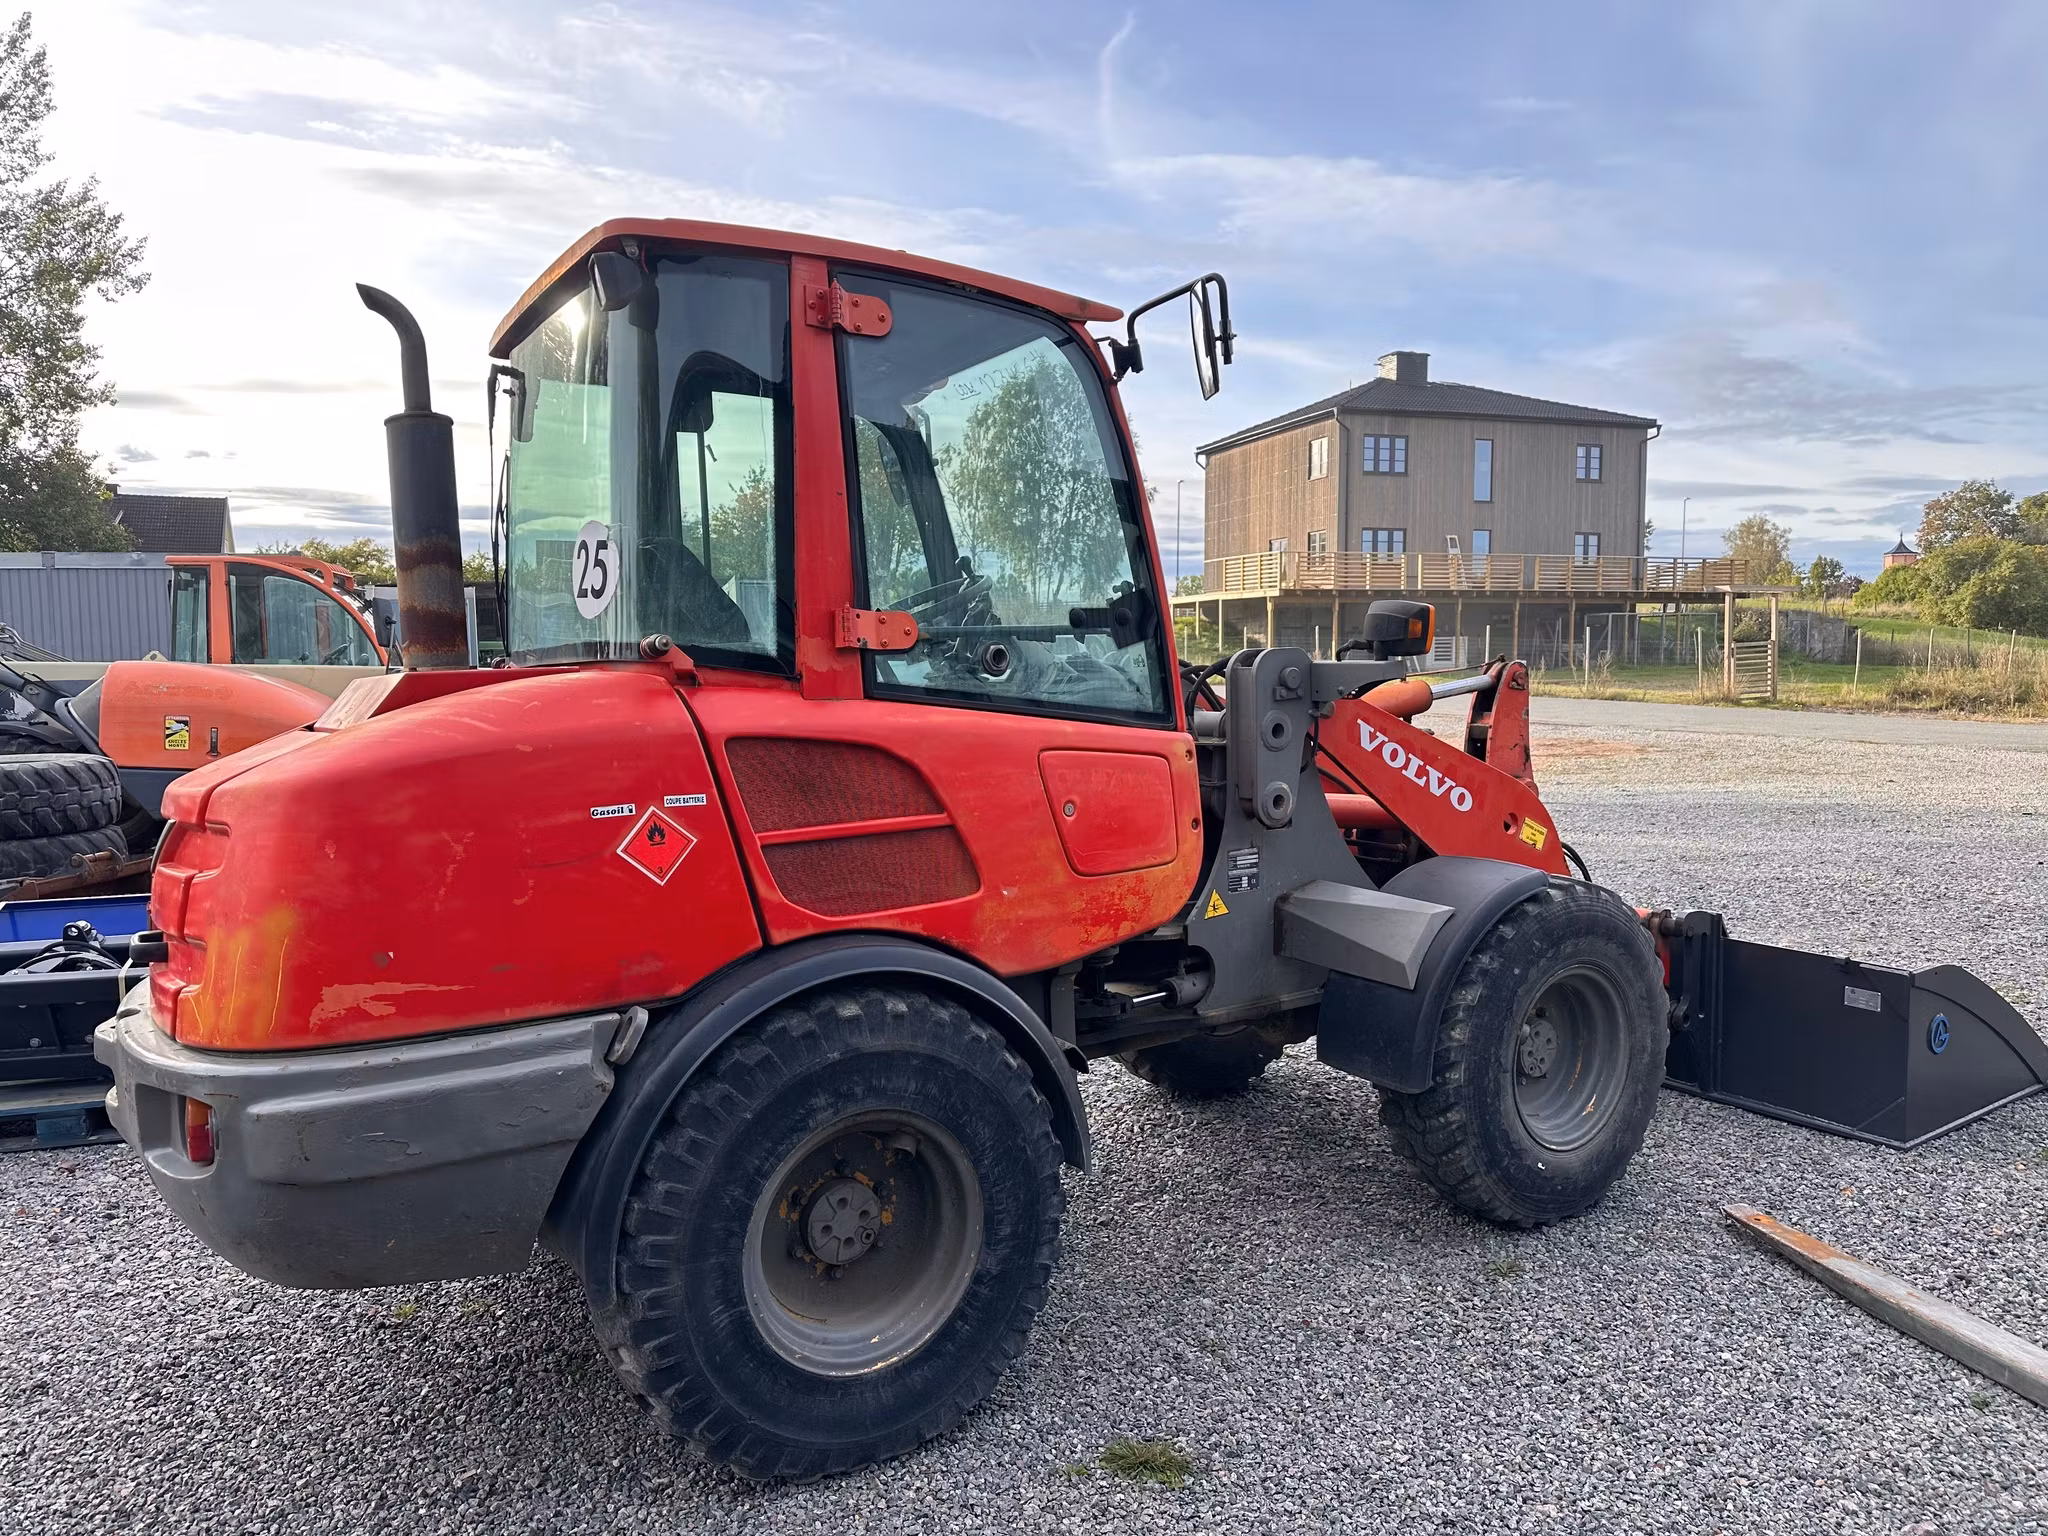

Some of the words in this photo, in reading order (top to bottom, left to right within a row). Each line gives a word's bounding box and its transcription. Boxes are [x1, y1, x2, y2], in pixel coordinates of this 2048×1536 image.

[576, 539, 608, 600] 25
[1356, 718, 1473, 812] VOLVO
[666, 797, 682, 805] COUPE
[682, 796, 705, 804] BATTERIE
[591, 806, 625, 818] Gasoil
[657, 866, 663, 874] 3
